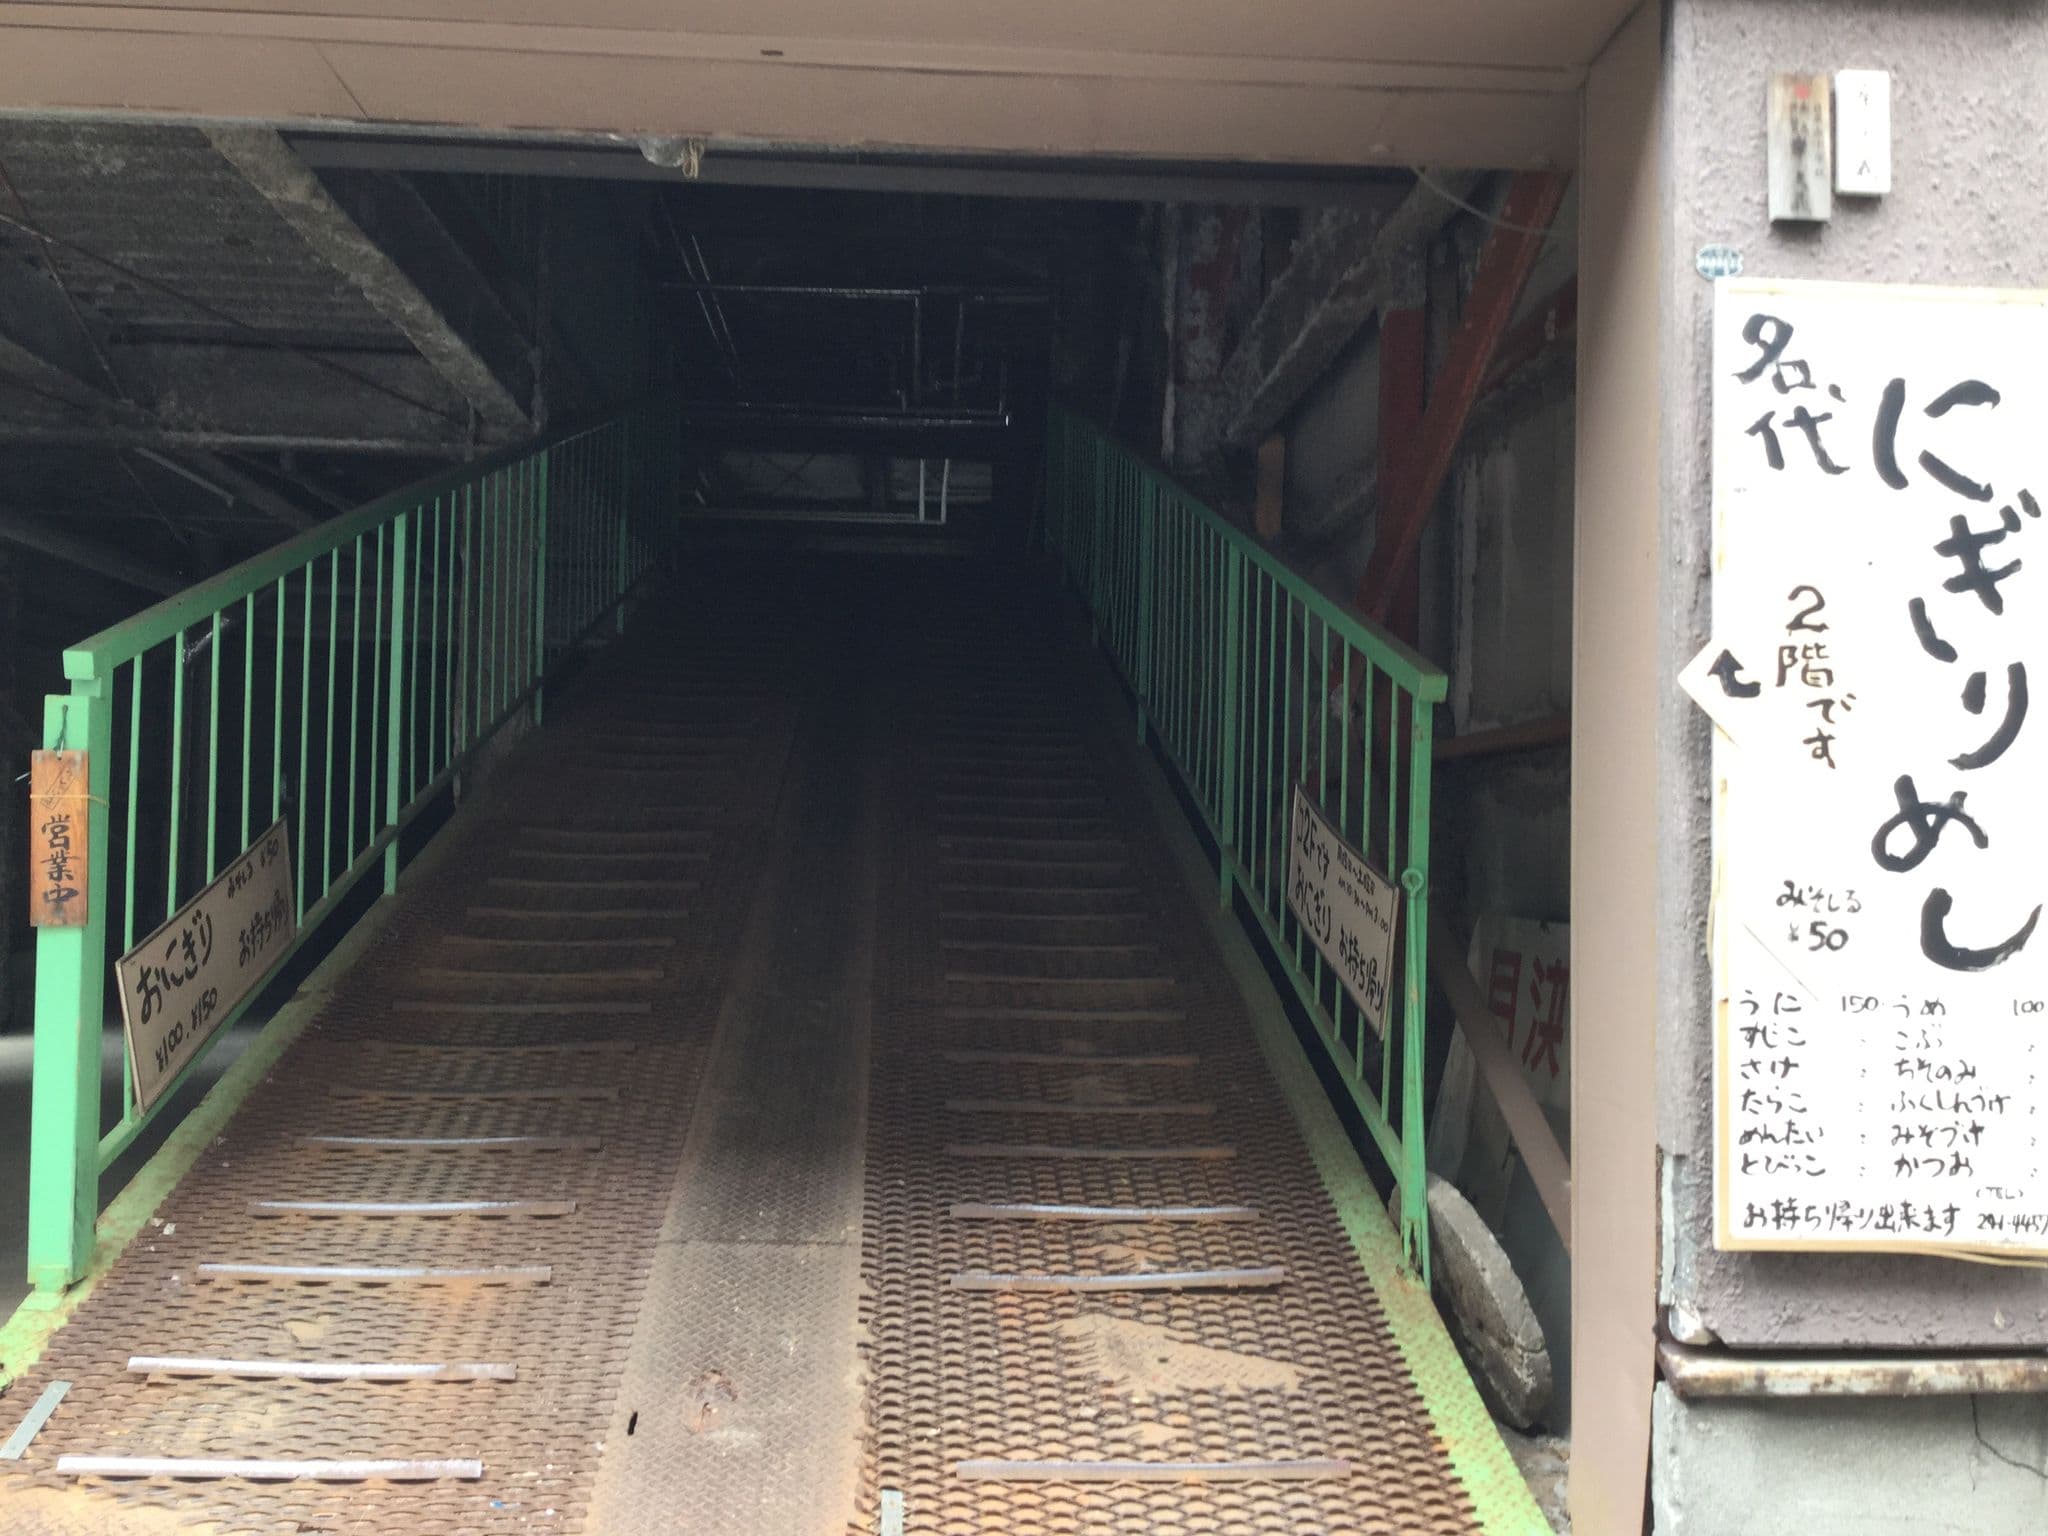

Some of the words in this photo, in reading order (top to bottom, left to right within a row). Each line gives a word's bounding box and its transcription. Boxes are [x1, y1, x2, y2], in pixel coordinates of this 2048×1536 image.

[1731, 313, 1850, 476] 名代
[1776, 585, 1856, 770] 2階です
[1870, 377, 2043, 973] にぎりめし
[41, 814, 80, 912] 営業中
[1295, 862, 1331, 944] おにぎり
[1776, 880, 1862, 913] みそしる
[137, 908, 213, 1025] おにぎり
[1740, 989, 1802, 1015] うに
[1842, 995, 1878, 1013] 150
[1893, 994, 1946, 1018] うめ
[2013, 999, 2045, 1016] 100
[1739, 1022, 1806, 1049] すじこ
[1740, 1056, 1799, 1080] さけ
[1741, 1085, 1807, 1115] たらこ
[1739, 1119, 1824, 1146] めんたい
[1743, 1196, 1960, 1236] お持ち帰り出来ます
